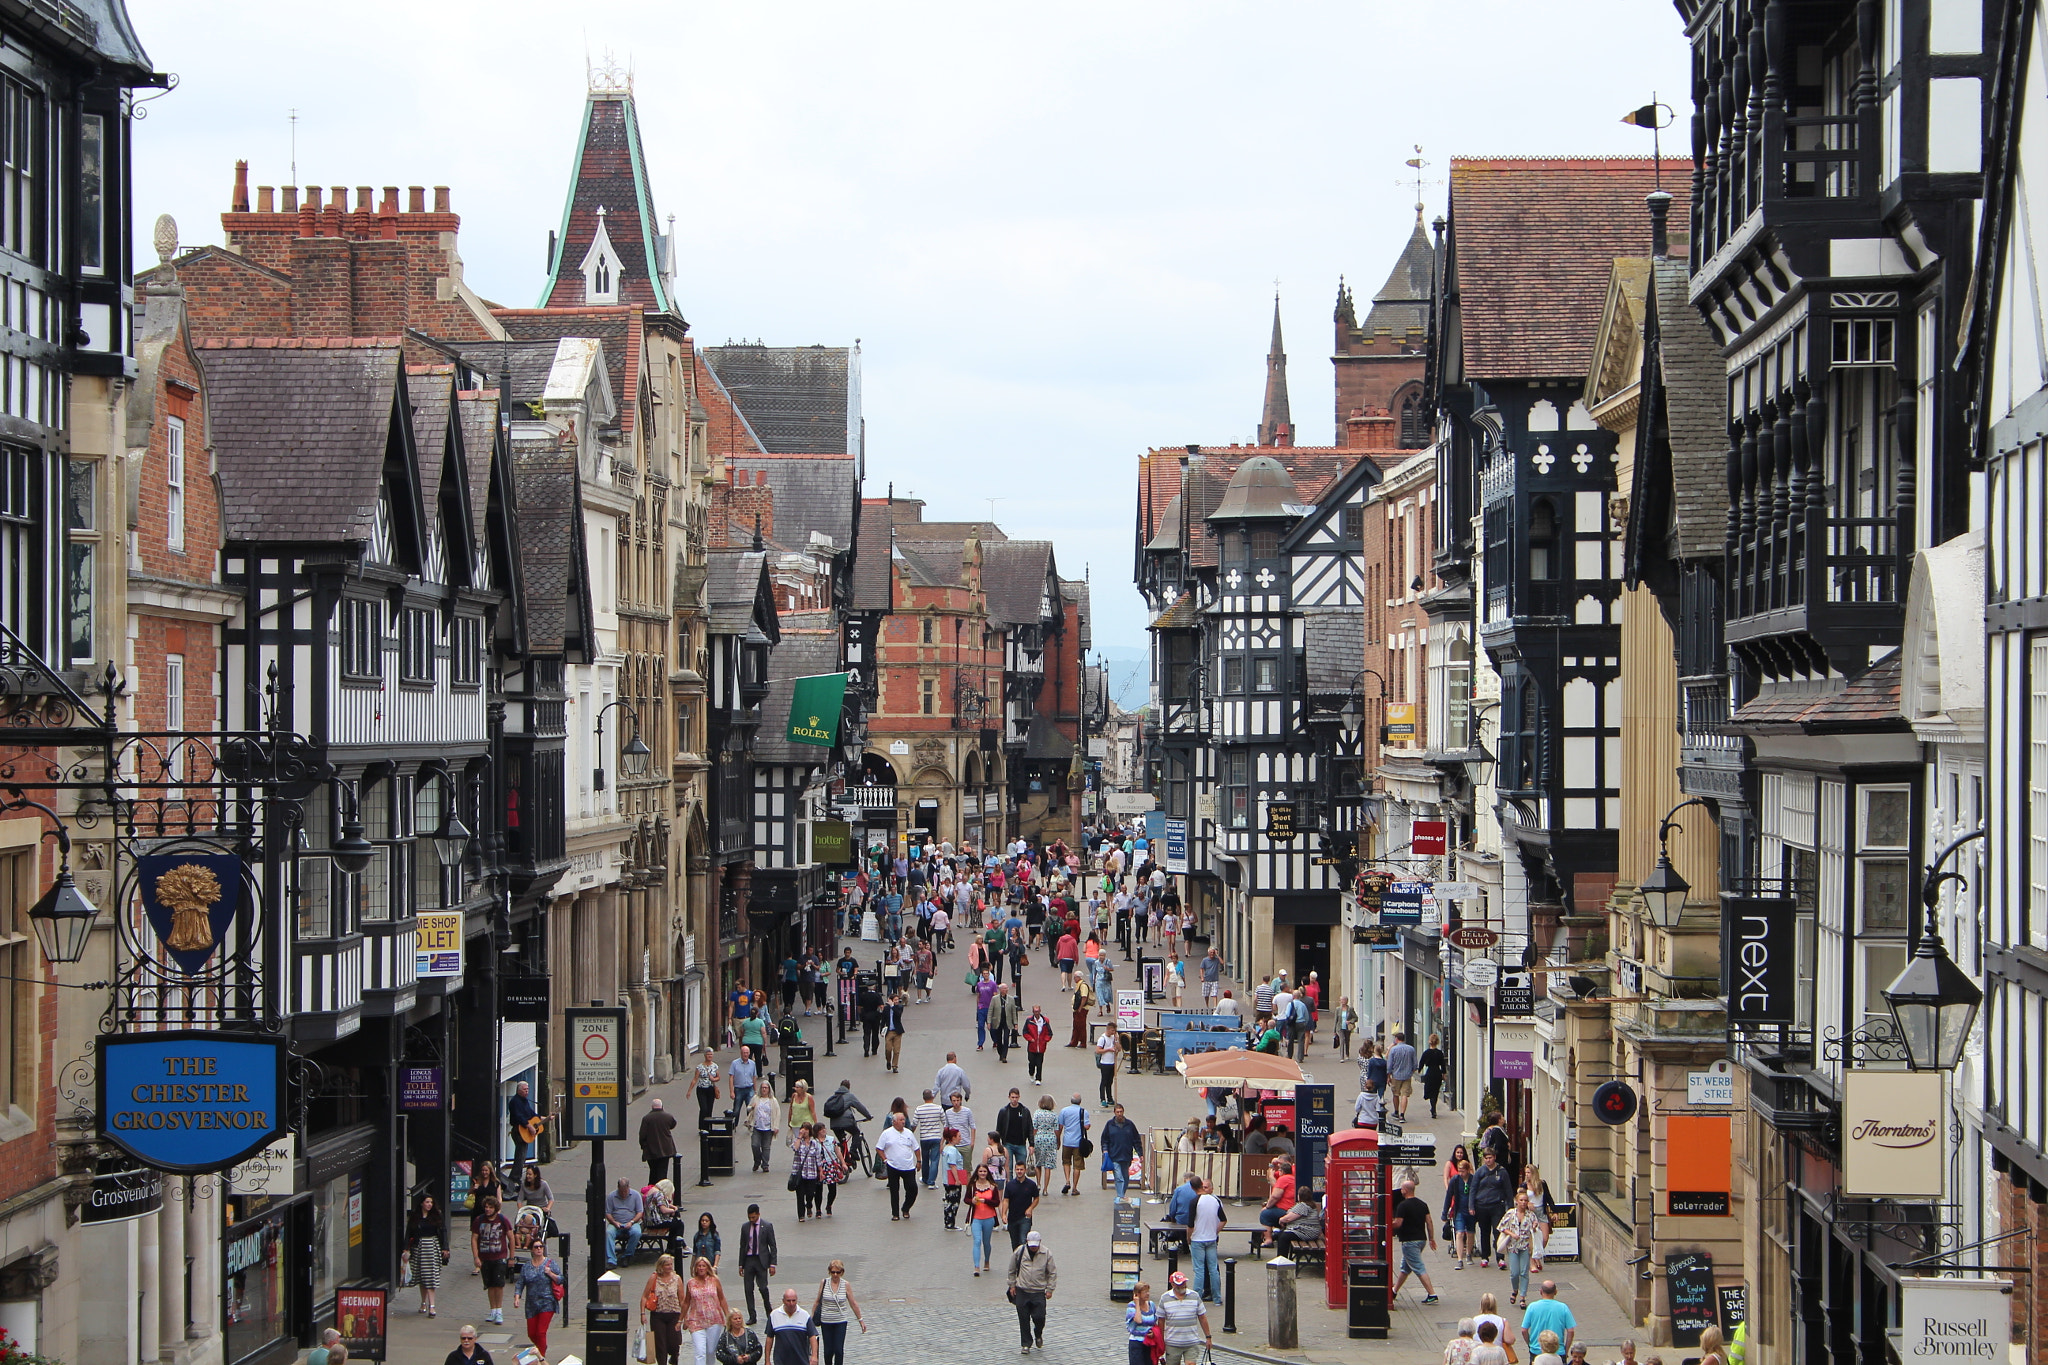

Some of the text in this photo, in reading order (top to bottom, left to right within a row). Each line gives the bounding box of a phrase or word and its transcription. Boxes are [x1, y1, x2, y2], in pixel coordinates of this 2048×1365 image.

[793, 726, 830, 739] ROLEX
[1271, 813, 1292, 822] Boot
[1273, 822, 1289, 830] Inn
[815, 835, 845, 845] hotter
[1394, 886, 1411, 894] SHOP
[431, 917, 457, 929] SHOP
[427, 930, 455, 948] LET
[1461, 930, 1490, 938] BELLA
[1740, 915, 1770, 1012] next
[582, 1024, 609, 1033] ZONE
[163, 1057, 218, 1076] THE
[406, 1082, 436, 1090] TO LET
[1690, 1076, 1702, 1086] ST.
[132, 1084, 250, 1104] CHESTER
[112, 1111, 269, 1130] GROSVENOR
[1301, 1117, 1312, 1125] The
[1852, 1119, 1930, 1141] Thorntons
[241, 1163, 283, 1172] apothecary
[92, 1183, 149, 1207] Grosvenor
[351, 1199, 360, 1211] SHOP
[227, 1232, 261, 1276] #DEMAND
[1687, 1284, 1707, 1295] English
[1722, 1290, 1740, 1300] THE
[341, 1296, 380, 1306] #DEMAND
[1676, 1295, 1704, 1305] Breakfast
[1923, 1317, 1988, 1337] Russell
[1924, 1337, 1998, 1360] Bromley
